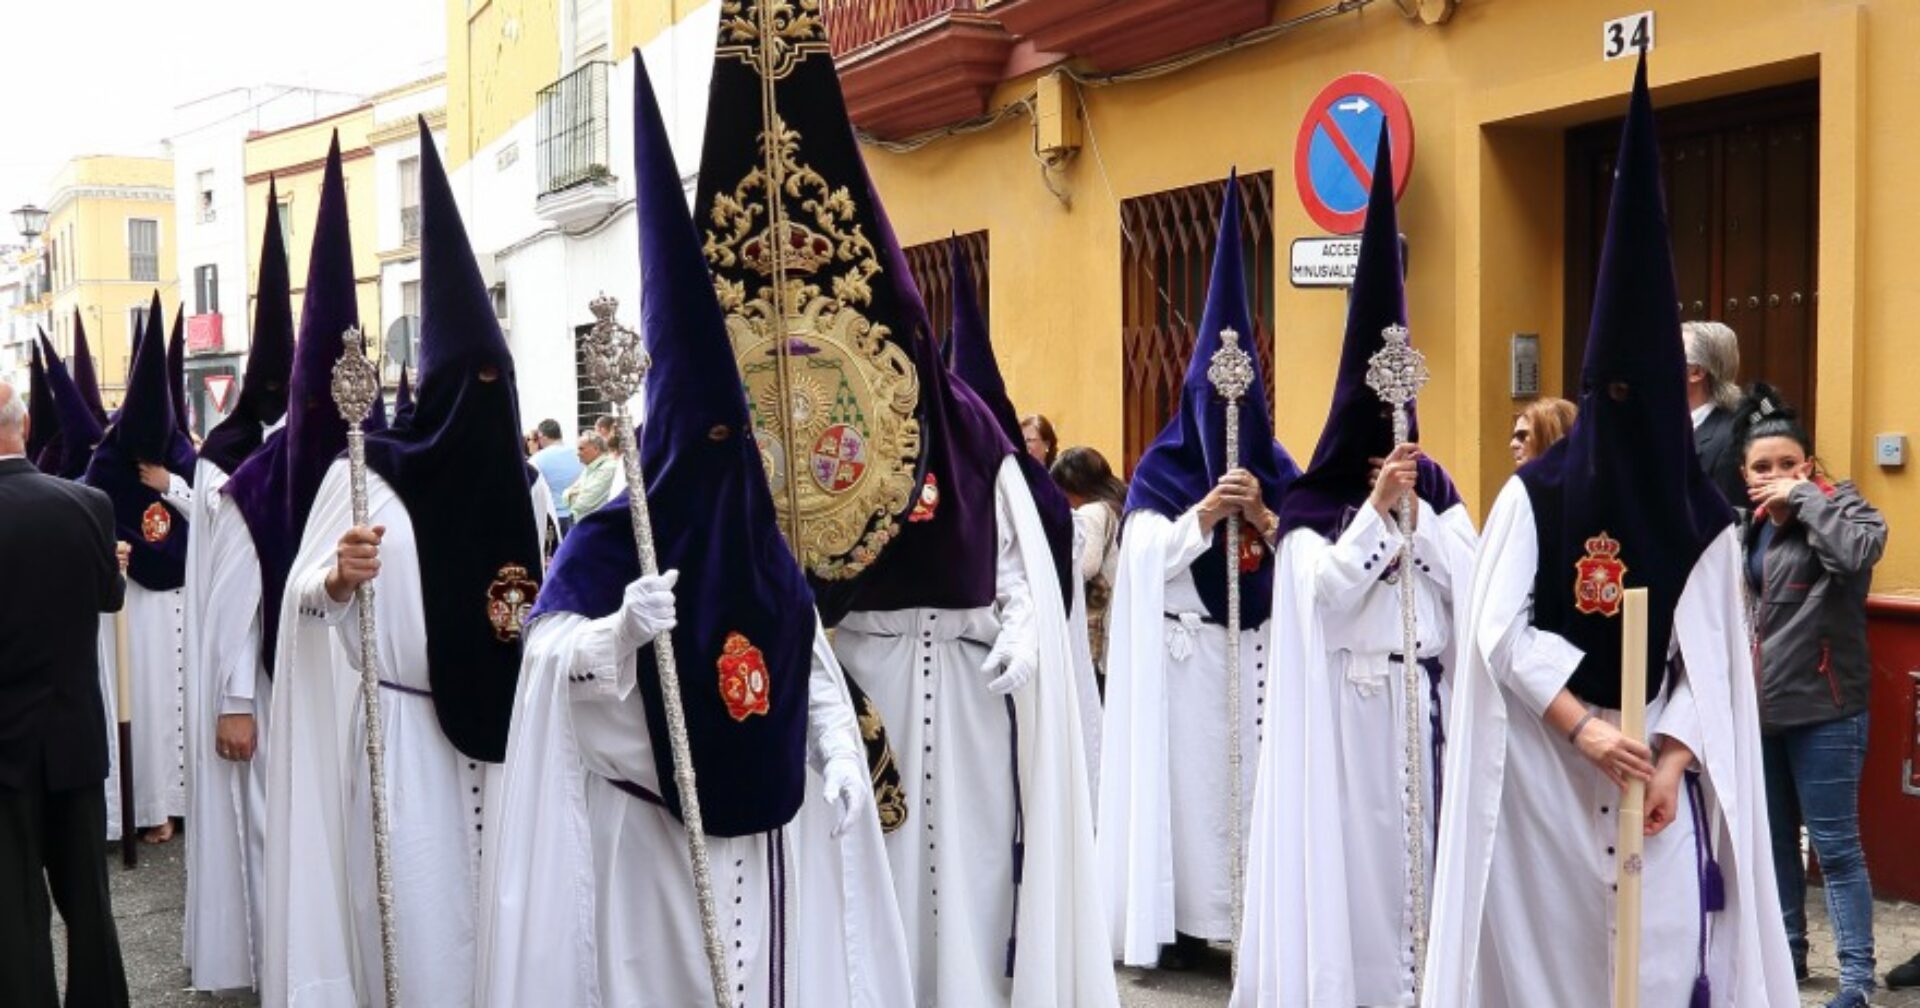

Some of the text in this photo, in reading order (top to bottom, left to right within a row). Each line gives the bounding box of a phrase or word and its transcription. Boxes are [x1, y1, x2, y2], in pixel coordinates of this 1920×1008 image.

[1606, 16, 1649, 57] 34
[1322, 243, 1359, 256] ACCES
[1293, 264, 1357, 278] MINUSVALID
